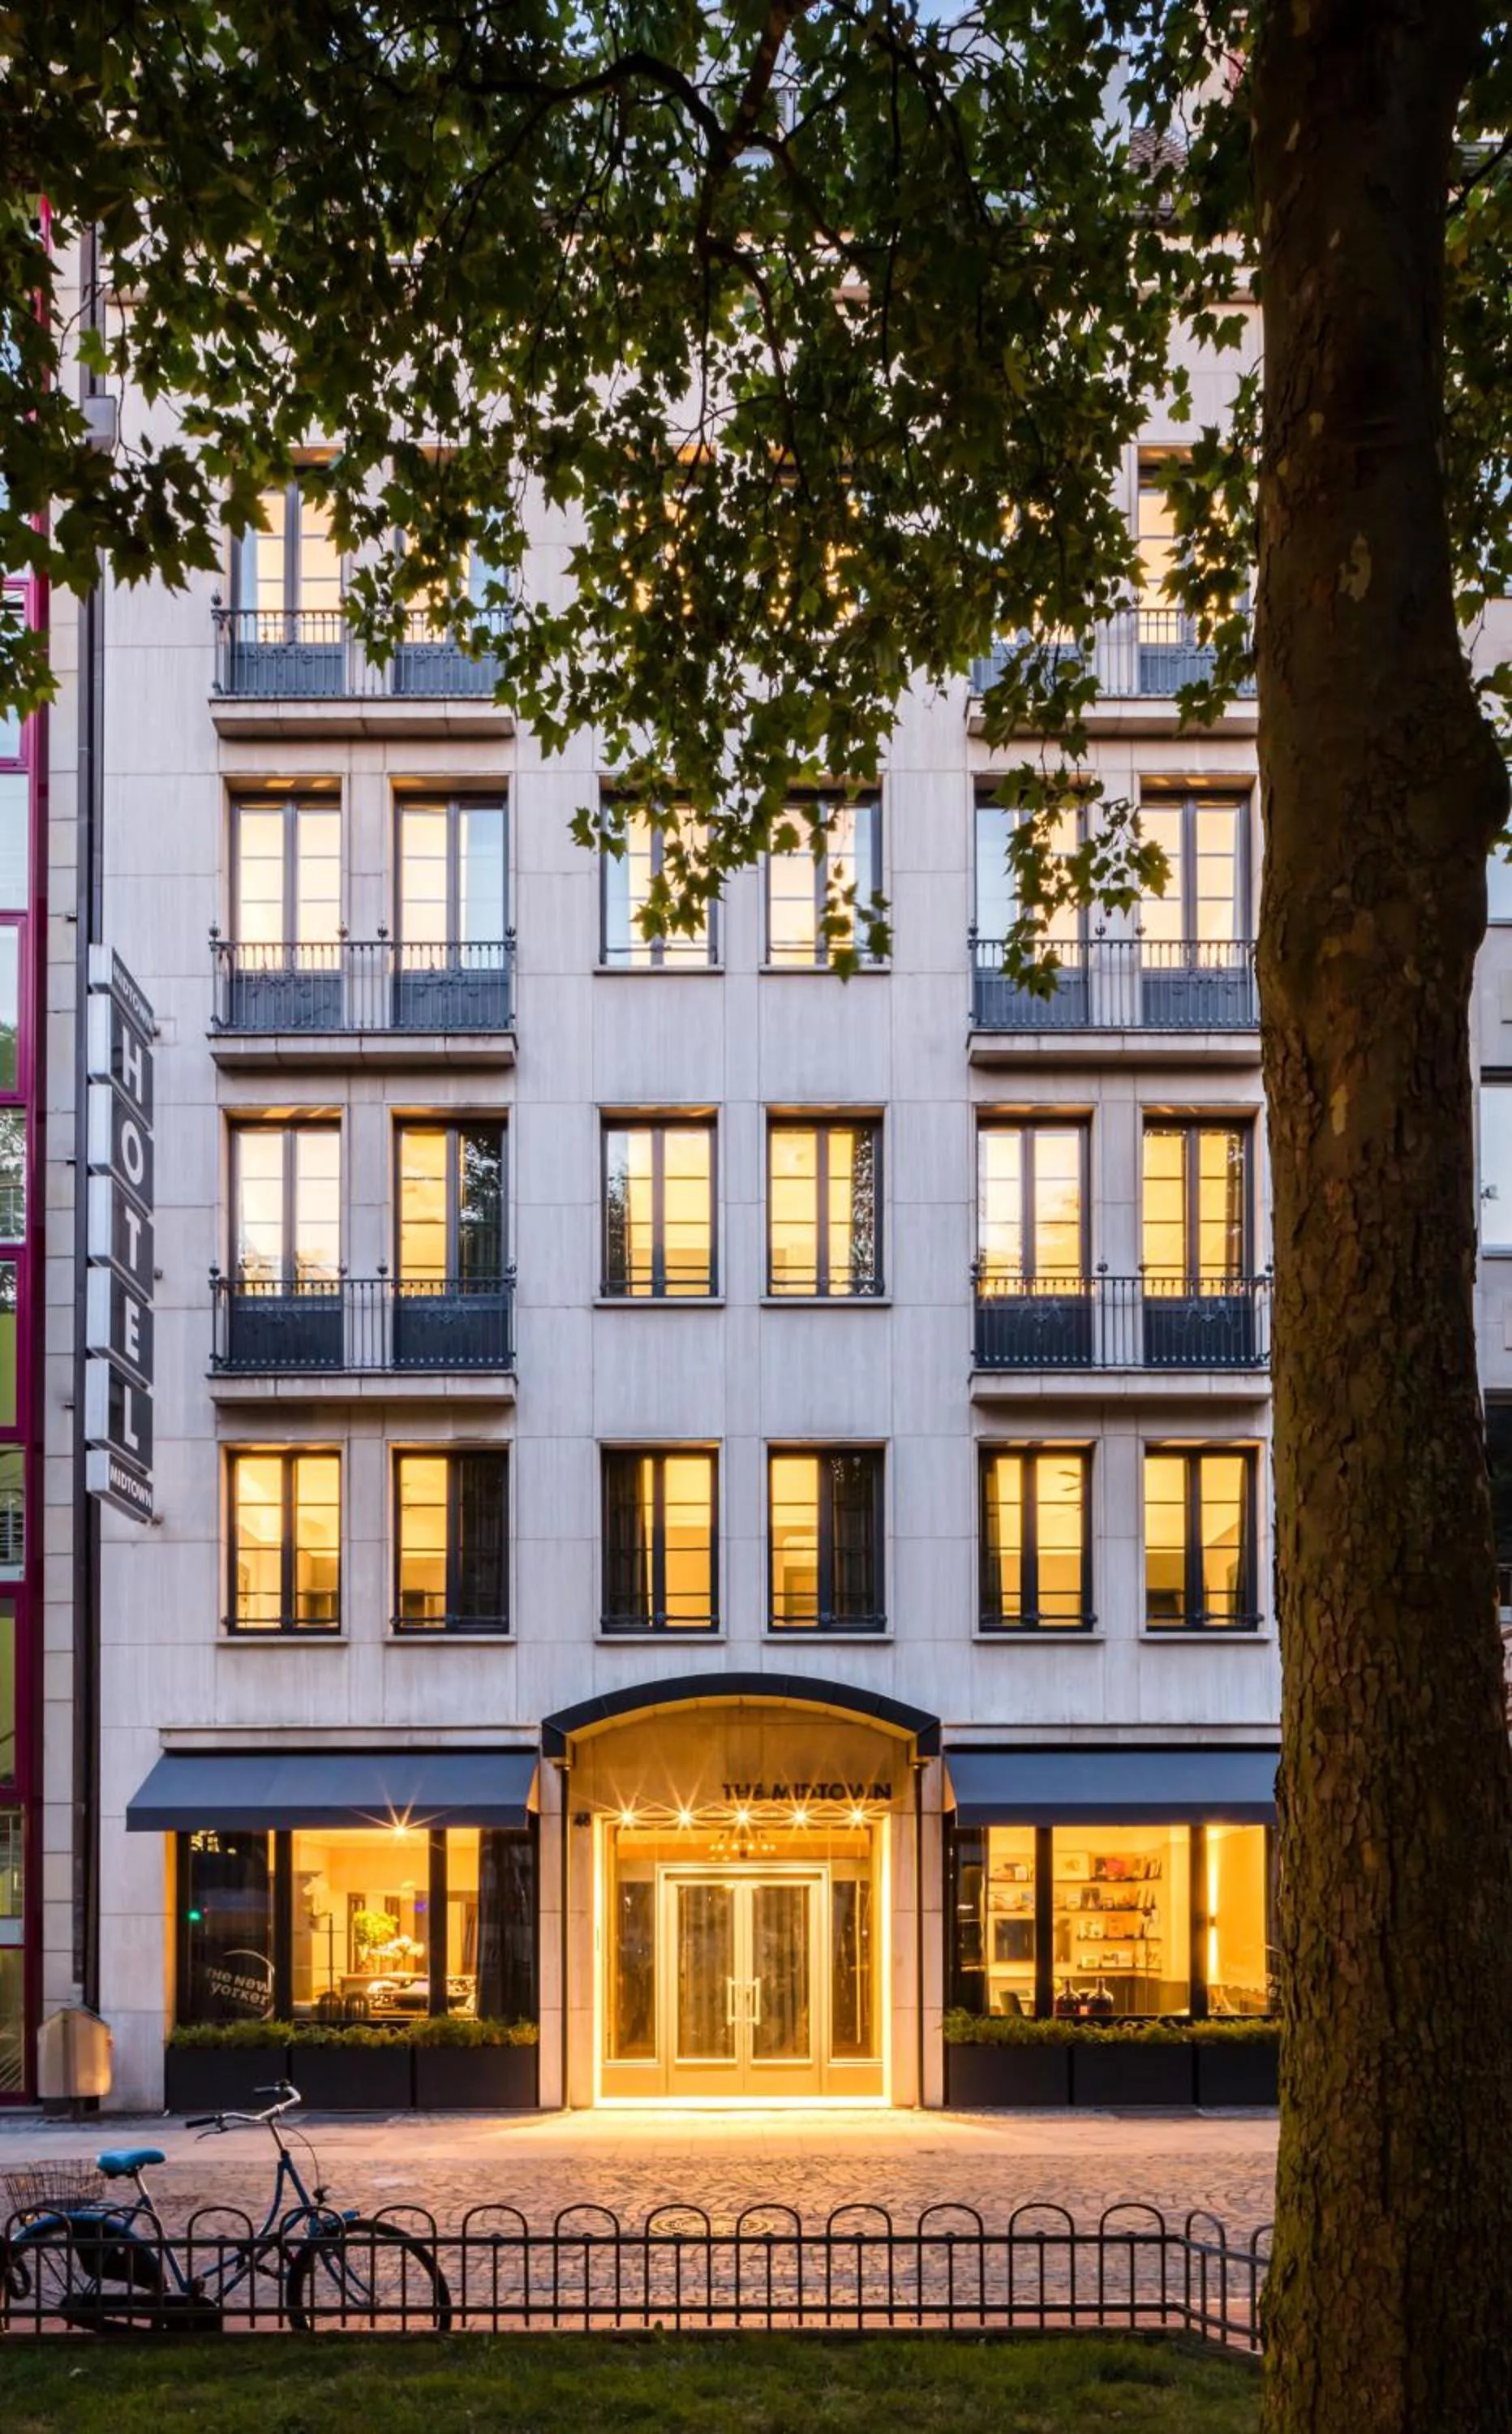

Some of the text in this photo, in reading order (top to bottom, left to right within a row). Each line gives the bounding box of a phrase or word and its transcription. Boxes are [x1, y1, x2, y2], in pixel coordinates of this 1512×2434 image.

[122, 1025, 144, 1451] HOTEL
[110, 1464, 152, 1508] MIDTOWN
[722, 1782, 891, 1800] THE MIDTOWN
